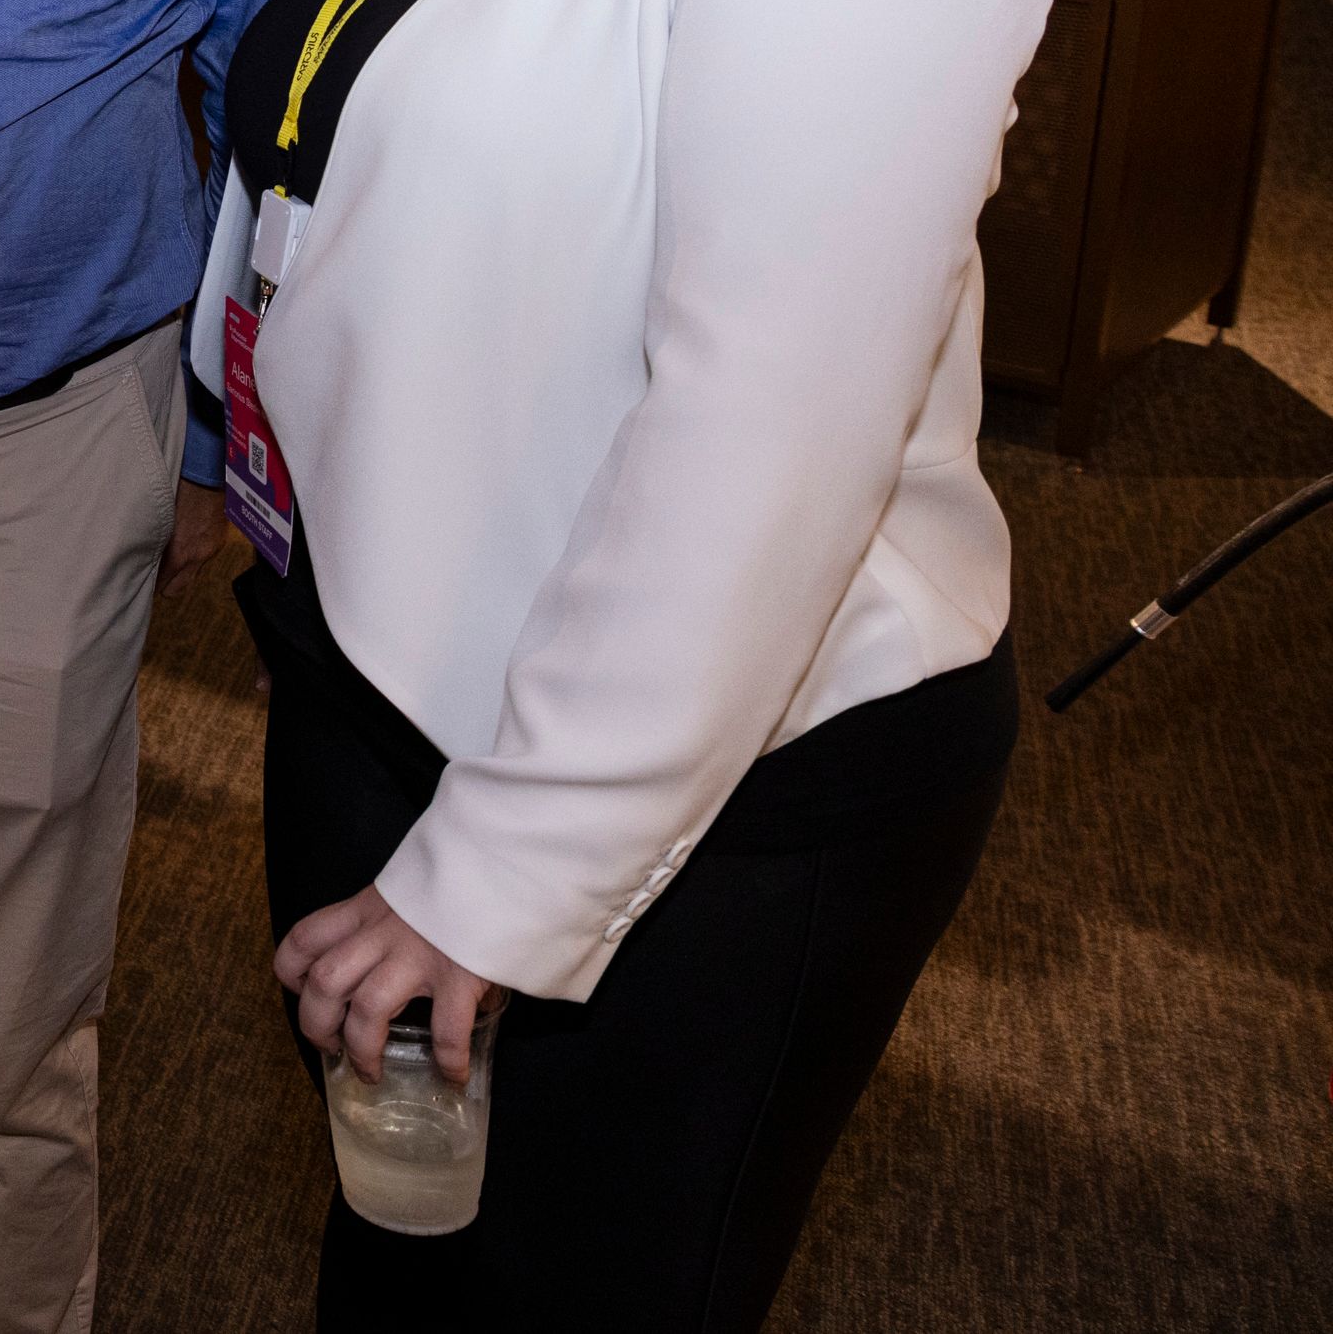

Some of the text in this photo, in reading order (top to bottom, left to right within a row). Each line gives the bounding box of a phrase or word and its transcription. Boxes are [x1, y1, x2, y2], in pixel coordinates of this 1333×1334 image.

[296, 32, 320, 81] SARTORIUS
[241, 504, 258, 528] BOOTH
[258, 519, 273, 541] STAFF
